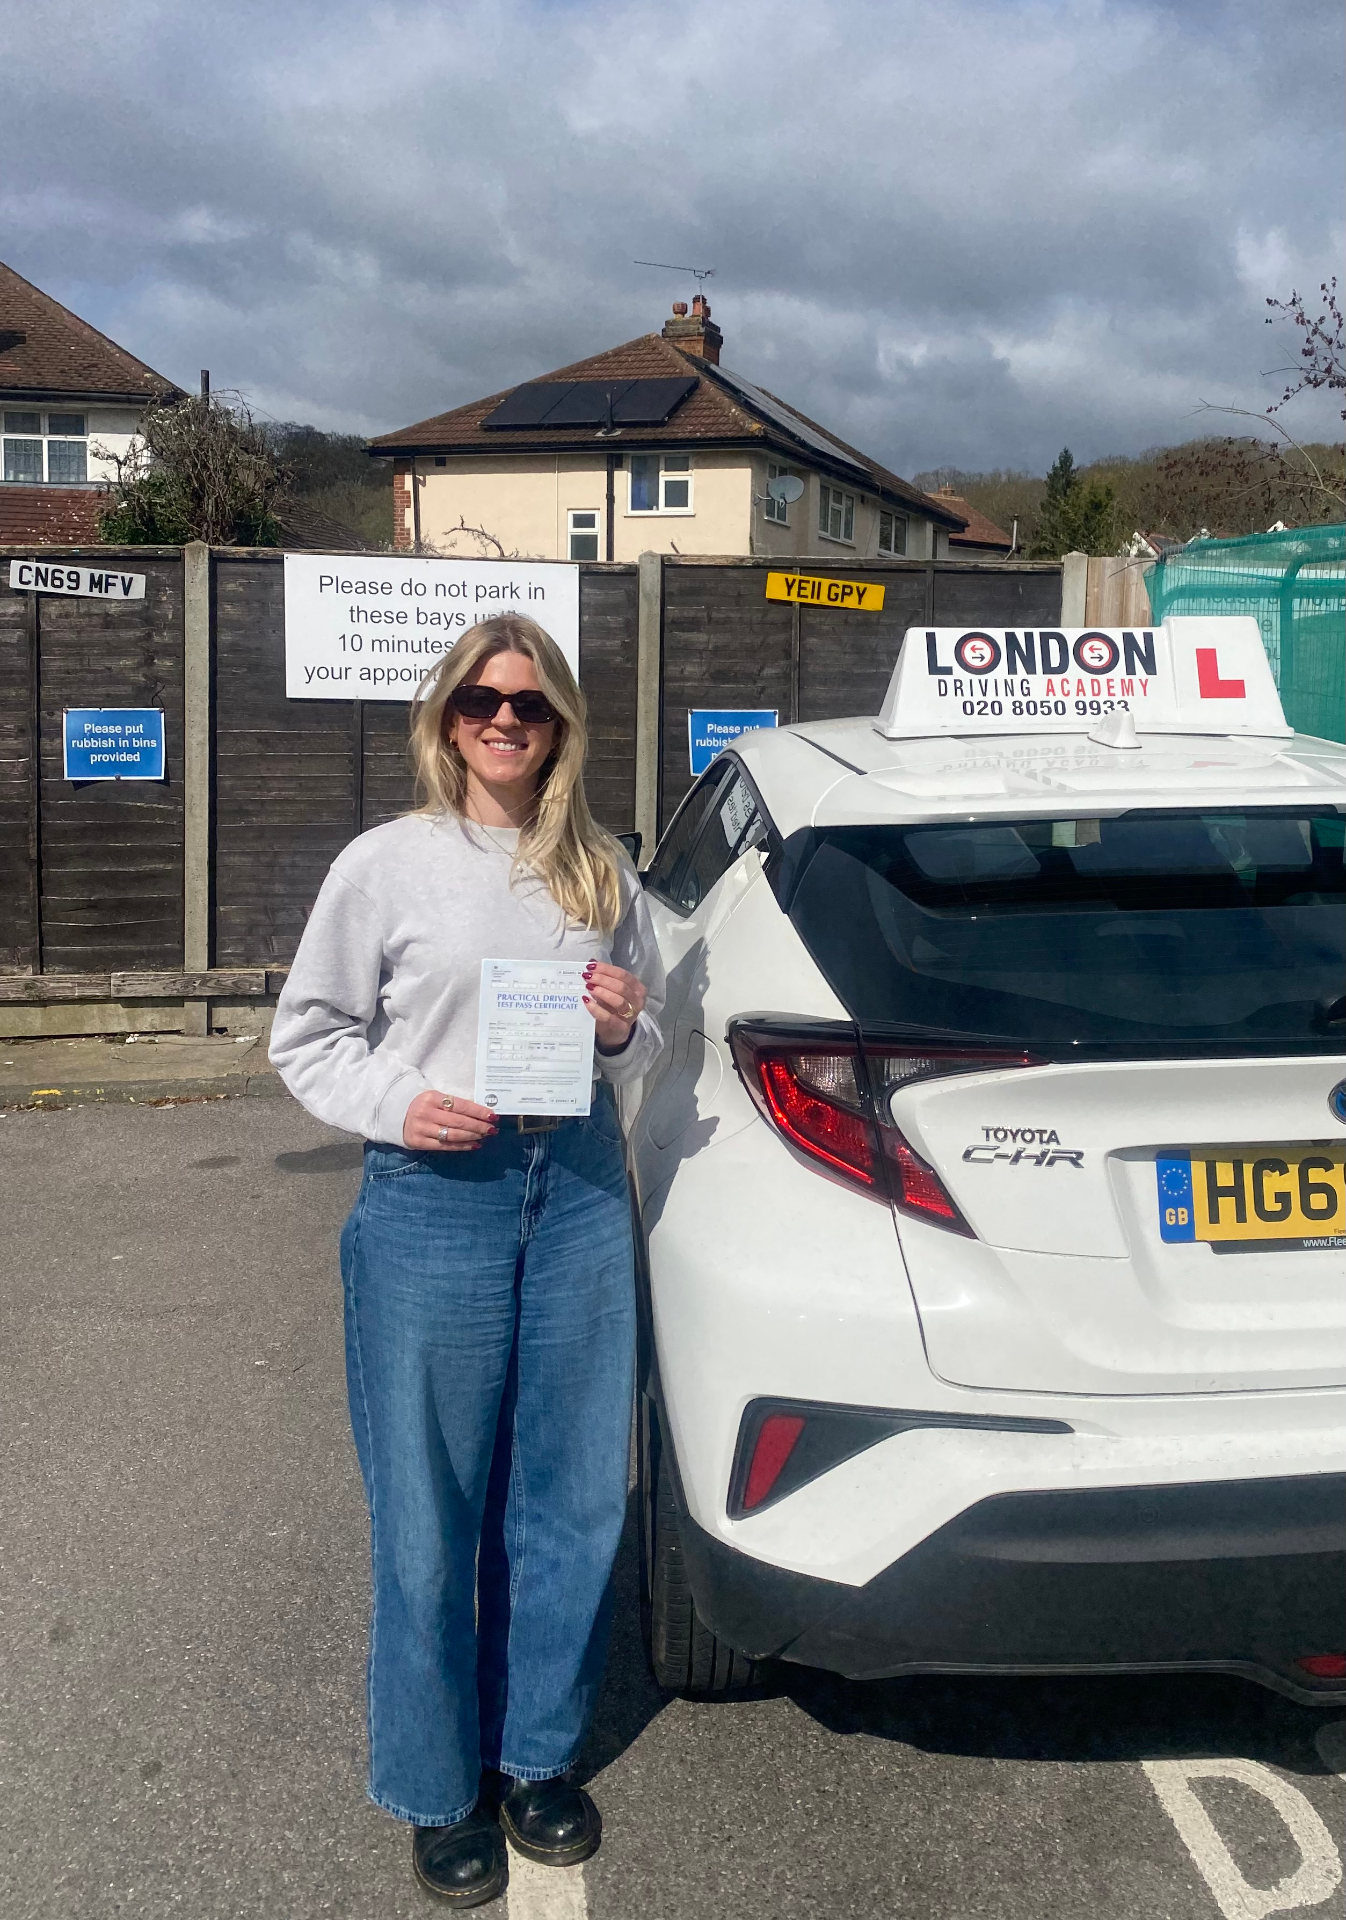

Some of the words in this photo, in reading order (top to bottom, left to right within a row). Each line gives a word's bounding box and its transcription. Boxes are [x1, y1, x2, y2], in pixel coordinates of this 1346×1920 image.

[18, 565, 80, 590] CN69
[89, 573, 133, 596] MFV
[319, 575, 393, 595] Please
[401, 578, 427, 597] do
[435, 581, 468, 598] not
[475, 582, 521, 604] park
[528, 582, 546, 600] in
[827, 583, 868, 605] GPY
[349, 605, 408, 625] these
[416, 607, 466, 630] bays
[338, 634, 363, 653] 10
[371, 635, 454, 654] minutes
[925, 631, 1158, 676] LONDON
[304, 666, 352, 685] your
[1195, 648, 1247, 699] L
[938, 678, 1032, 698] DRIVING
[1045, 678, 1150, 698] ACADEMY
[962, 700, 1003, 716] 020
[1011, 700, 1067, 716] 8050
[1075, 700, 1130, 716] 9933
[84, 723, 122, 734] Please
[125, 723, 144, 736] put
[707, 723, 741, 734] Please
[71, 737, 116, 748] rubbish
[118, 737, 129, 748] in
[132, 737, 157, 748] bins
[90, 751, 140, 764] provided
[497, 993, 541, 1002] PRACTICAL
[543, 994, 579, 1003] DRIVING
[534, 1002, 579, 1010] CERTIFICATE
[981, 1125, 1061, 1146] TOYOTA
[961, 1144, 1085, 1169] C-HR
[1205, 1157, 1346, 1225] HG6
[1165, 1207, 1189, 1226] GB
